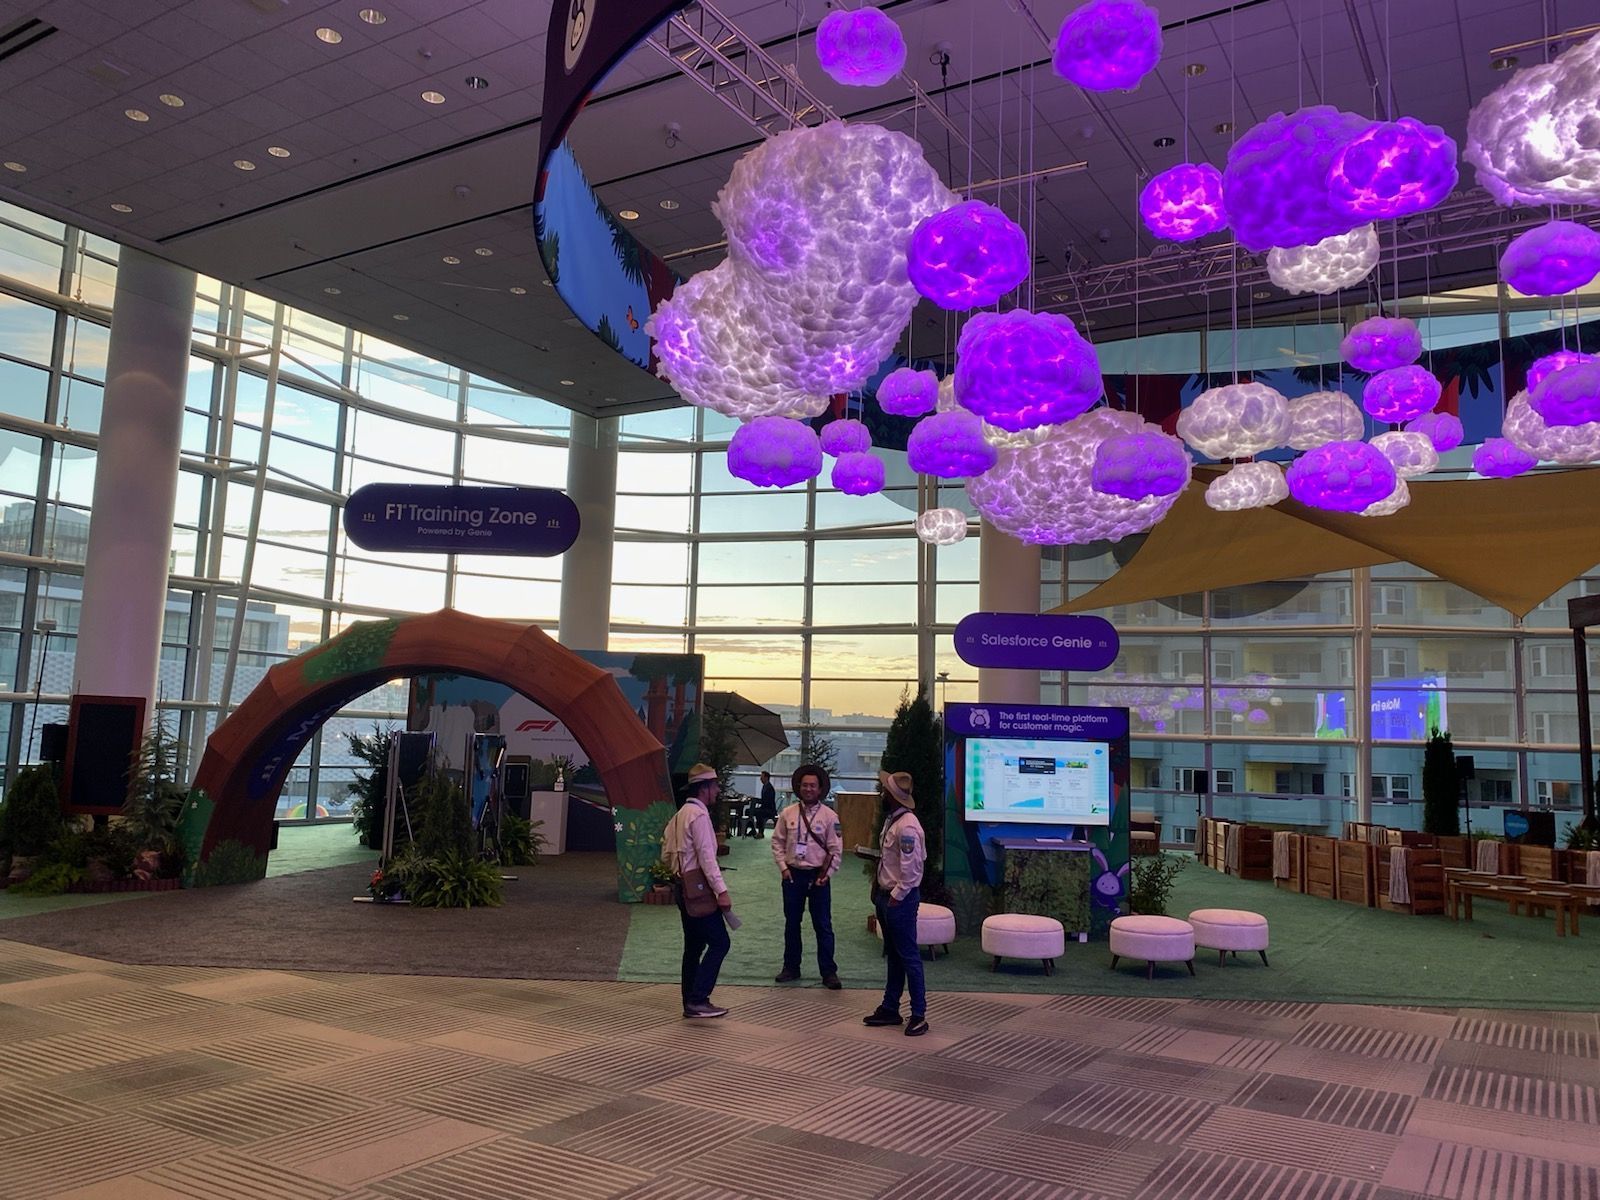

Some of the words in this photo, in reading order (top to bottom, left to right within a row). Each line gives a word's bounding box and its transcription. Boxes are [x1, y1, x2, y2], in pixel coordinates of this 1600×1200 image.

[409, 504, 483, 527] Training
[489, 507, 537, 525] Zone
[417, 527, 453, 536] Powered
[455, 527, 465, 537] by
[467, 528, 492, 537] Genie
[981, 633, 1048, 647] Salesforce
[1052, 635, 1092, 648] Genie
[999, 711, 1014, 720] The
[1016, 712, 1030, 720] first
[1032, 712, 1070, 721] real-time
[1072, 713, 1108, 723] platform
[515, 720, 559, 732] F1
[999, 721, 1011, 729] for
[1012, 721, 1052, 730] customer
[1054, 723, 1084, 733] magic.
